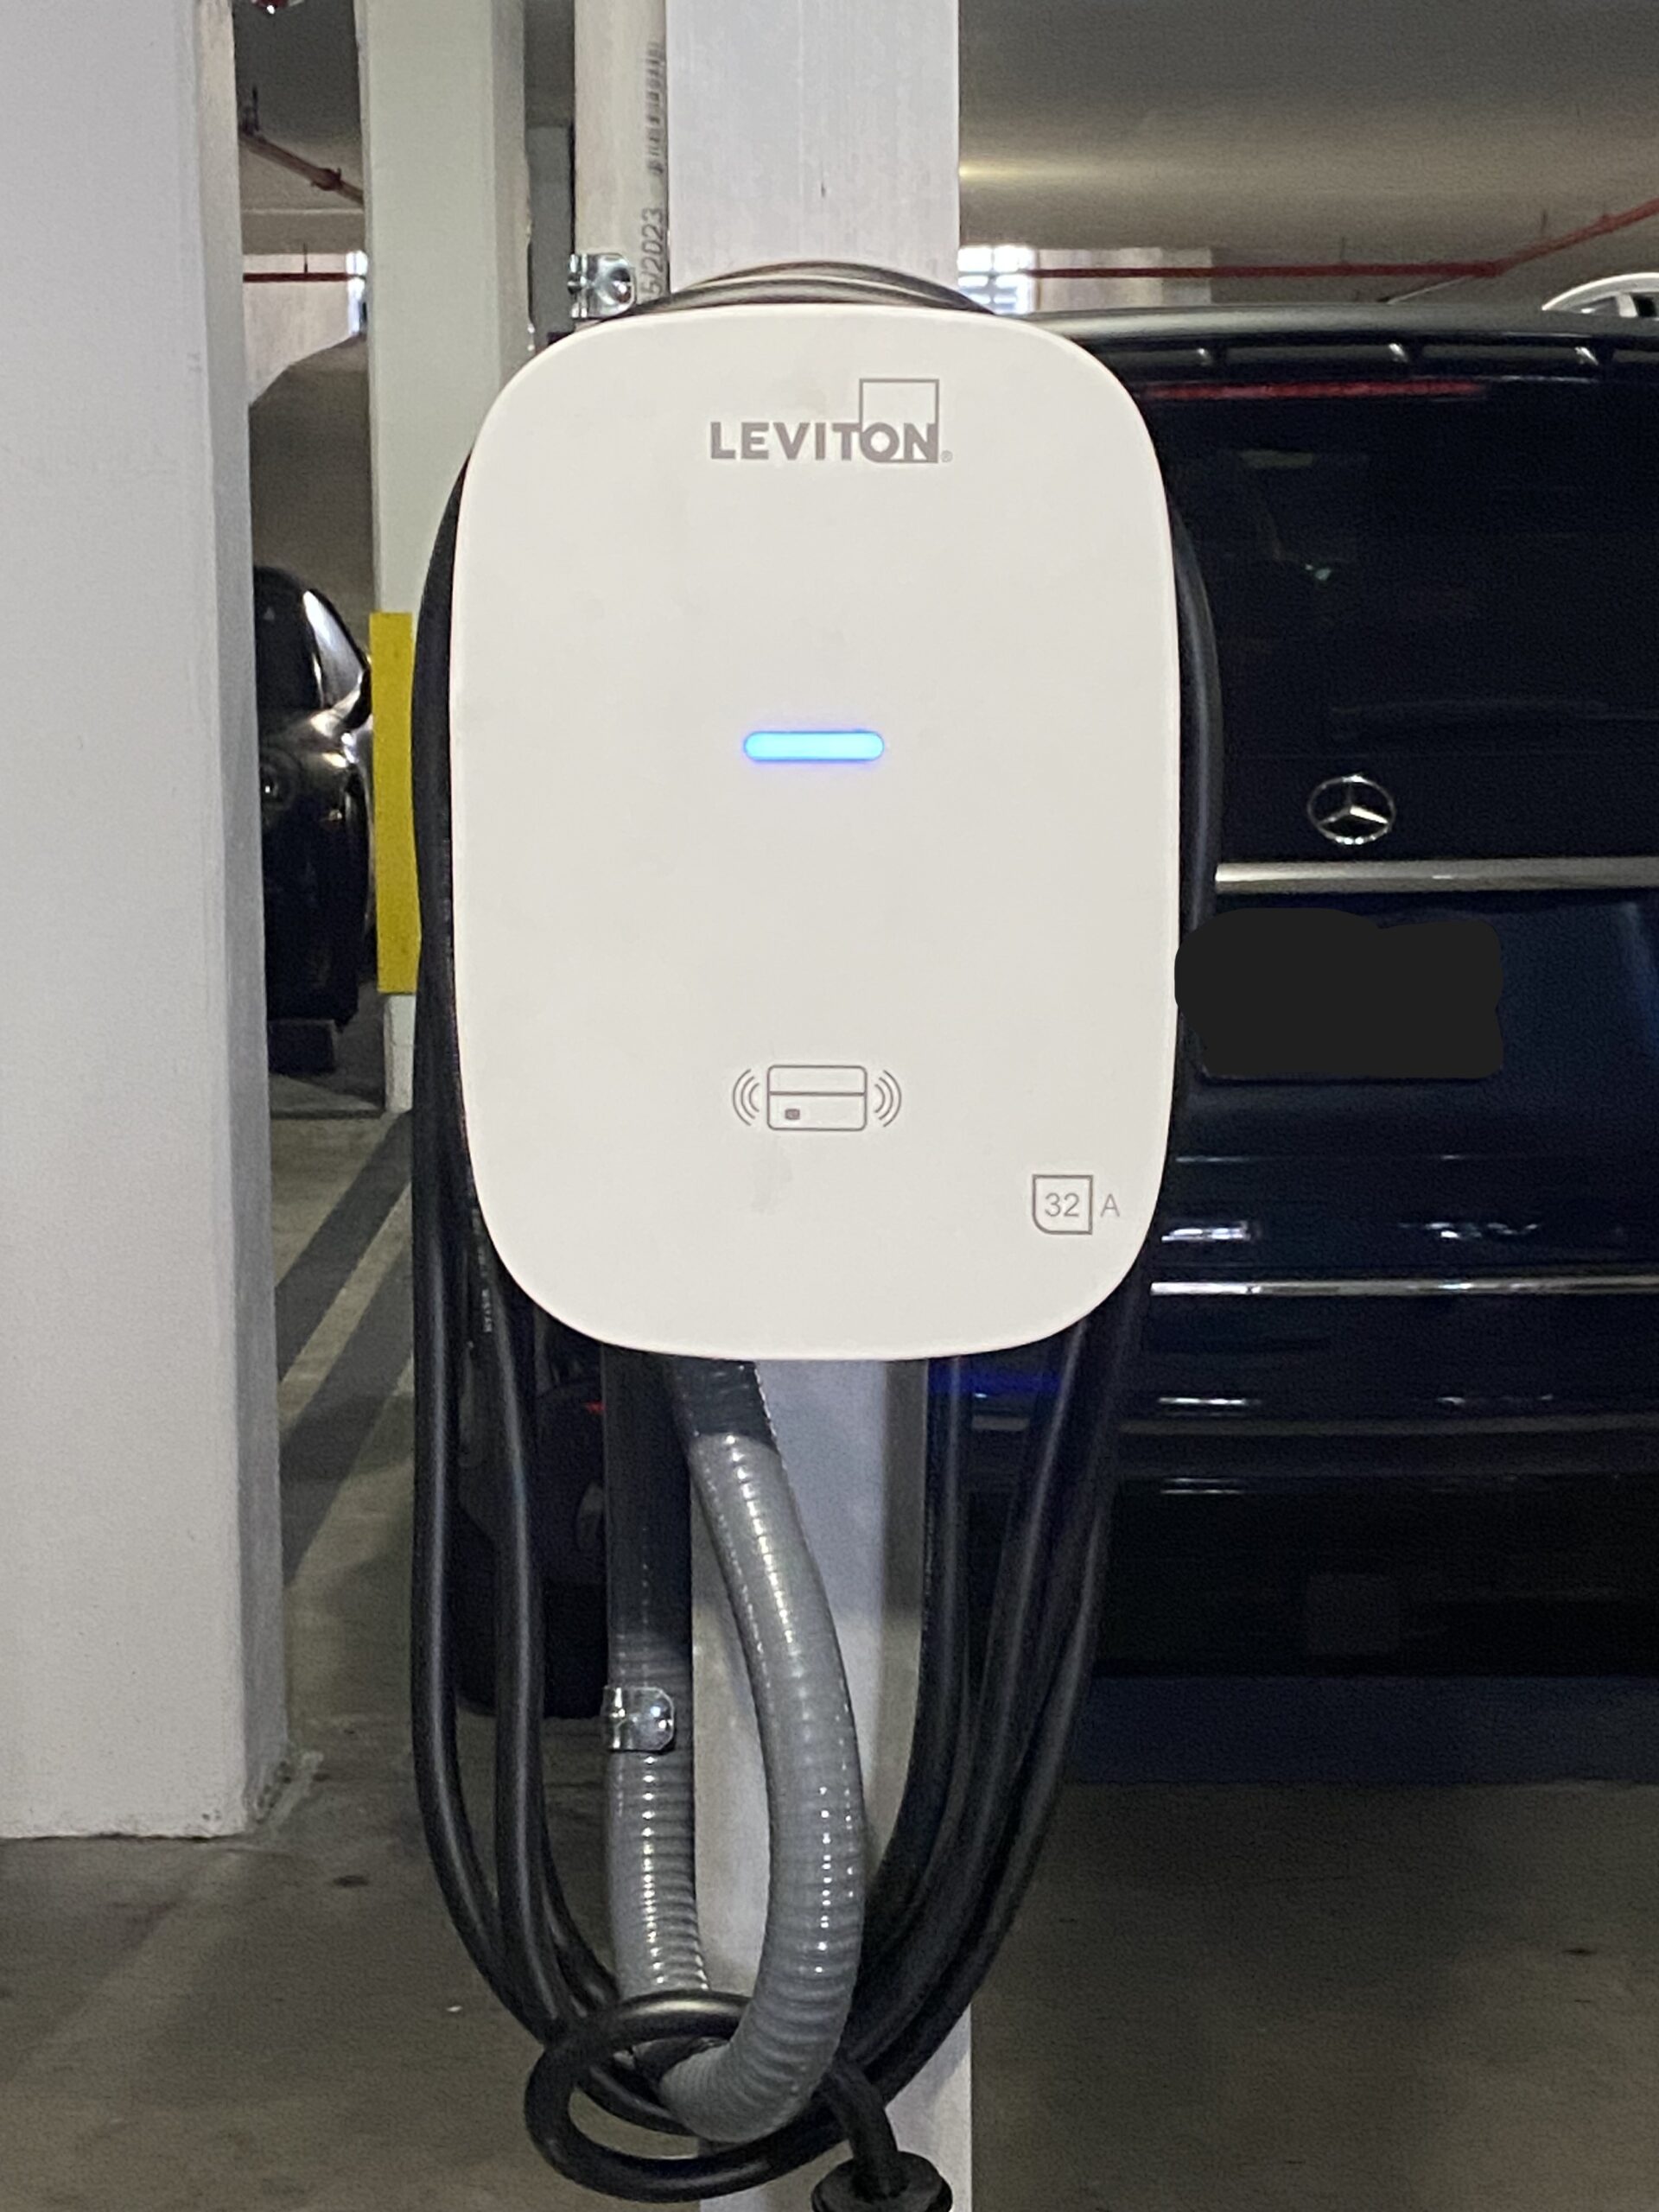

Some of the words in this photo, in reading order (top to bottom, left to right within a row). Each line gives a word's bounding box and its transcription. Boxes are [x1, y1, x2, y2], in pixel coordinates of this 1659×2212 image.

[709, 421, 938, 463] LEVITON
[1044, 1192, 1080, 1217] 32
[1100, 1192, 1121, 1217] A
